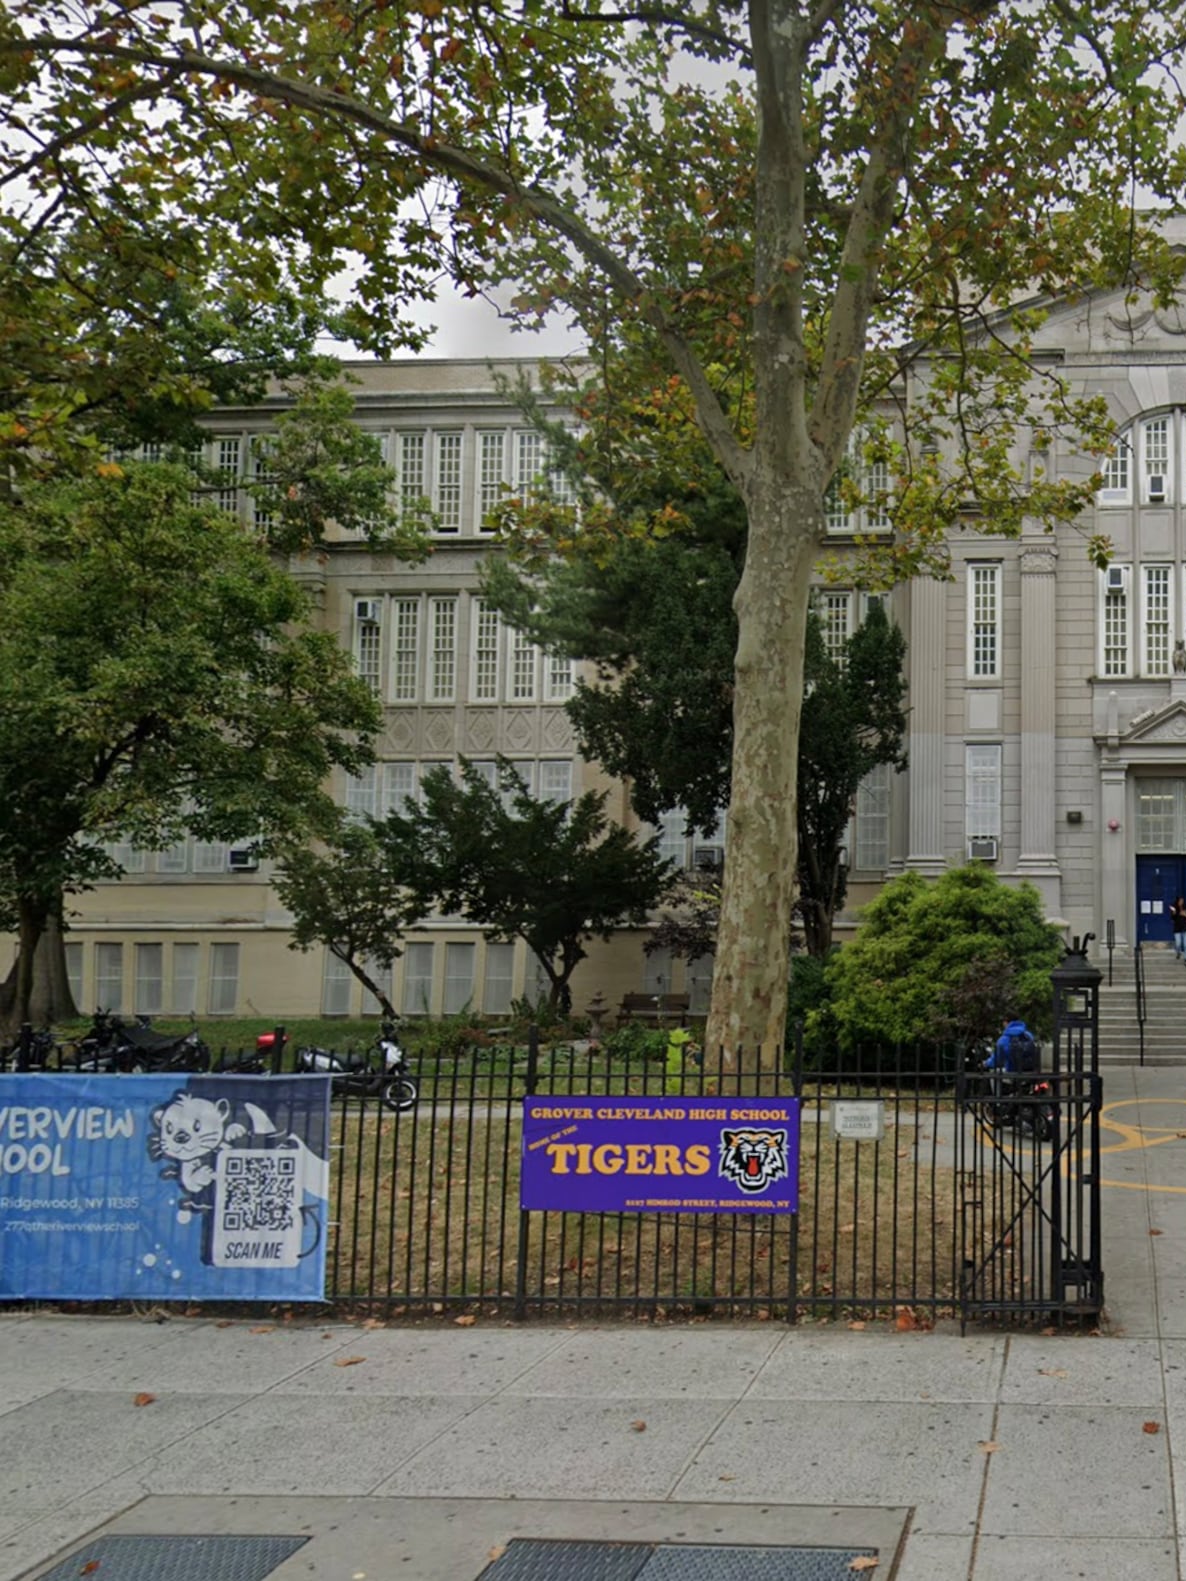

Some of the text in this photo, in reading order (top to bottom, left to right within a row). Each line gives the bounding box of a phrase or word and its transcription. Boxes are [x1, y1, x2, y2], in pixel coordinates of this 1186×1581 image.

[531, 1107, 790, 1121] GROVER CLEVELAND HIGH SCHOOL
[0, 1143, 71, 1176] OOL
[546, 1143, 711, 1176] TIGERS
[85, 1198, 104, 1209] NY
[224, 1242, 283, 1260] SCAN ME
